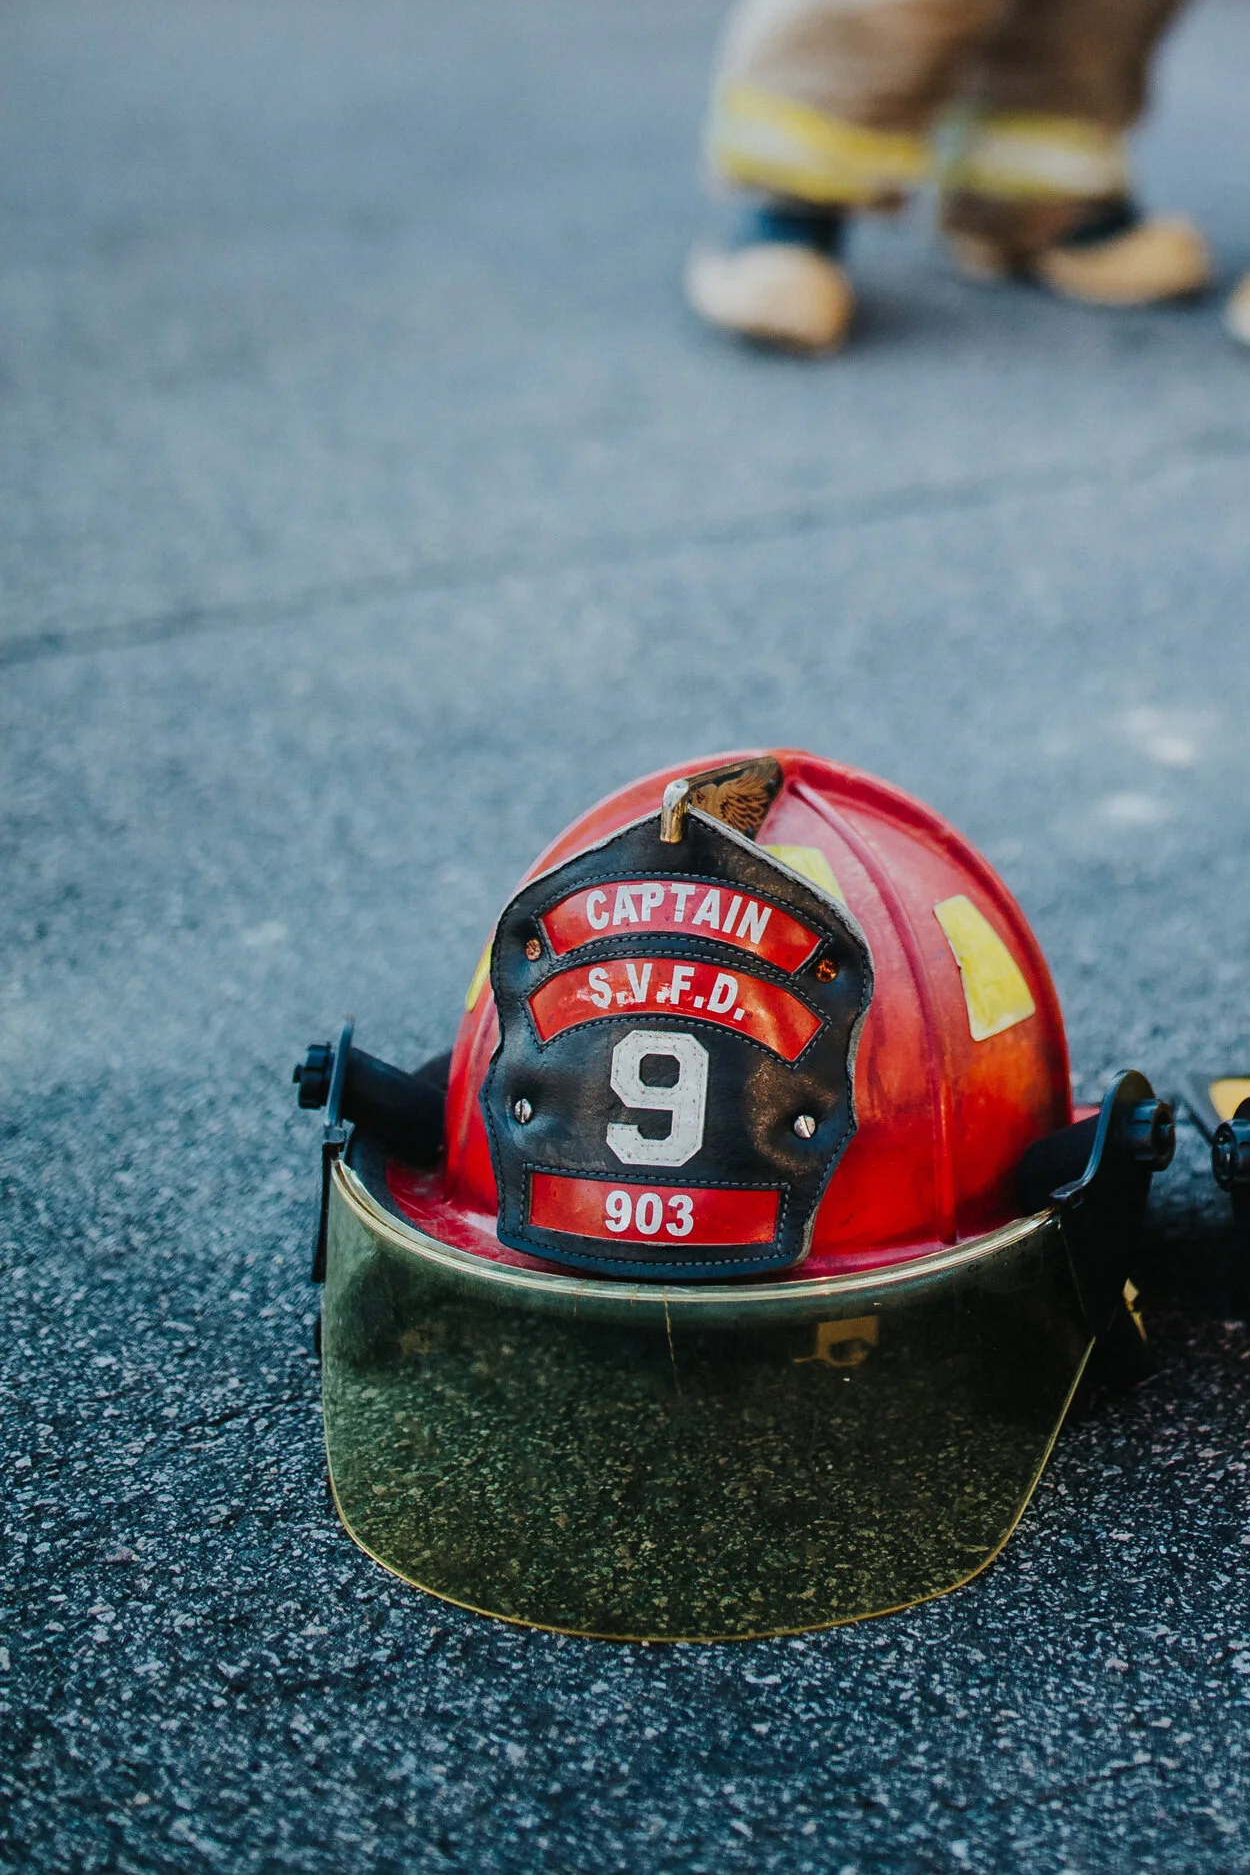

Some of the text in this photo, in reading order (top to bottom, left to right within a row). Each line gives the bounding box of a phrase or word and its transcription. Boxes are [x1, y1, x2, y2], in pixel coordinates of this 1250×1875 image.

[586, 882, 772, 945] CAPTAIN
[588, 962, 746, 1021] S.V.F.D.
[605, 1029, 710, 1167] 9
[604, 1189, 695, 1237] 903
